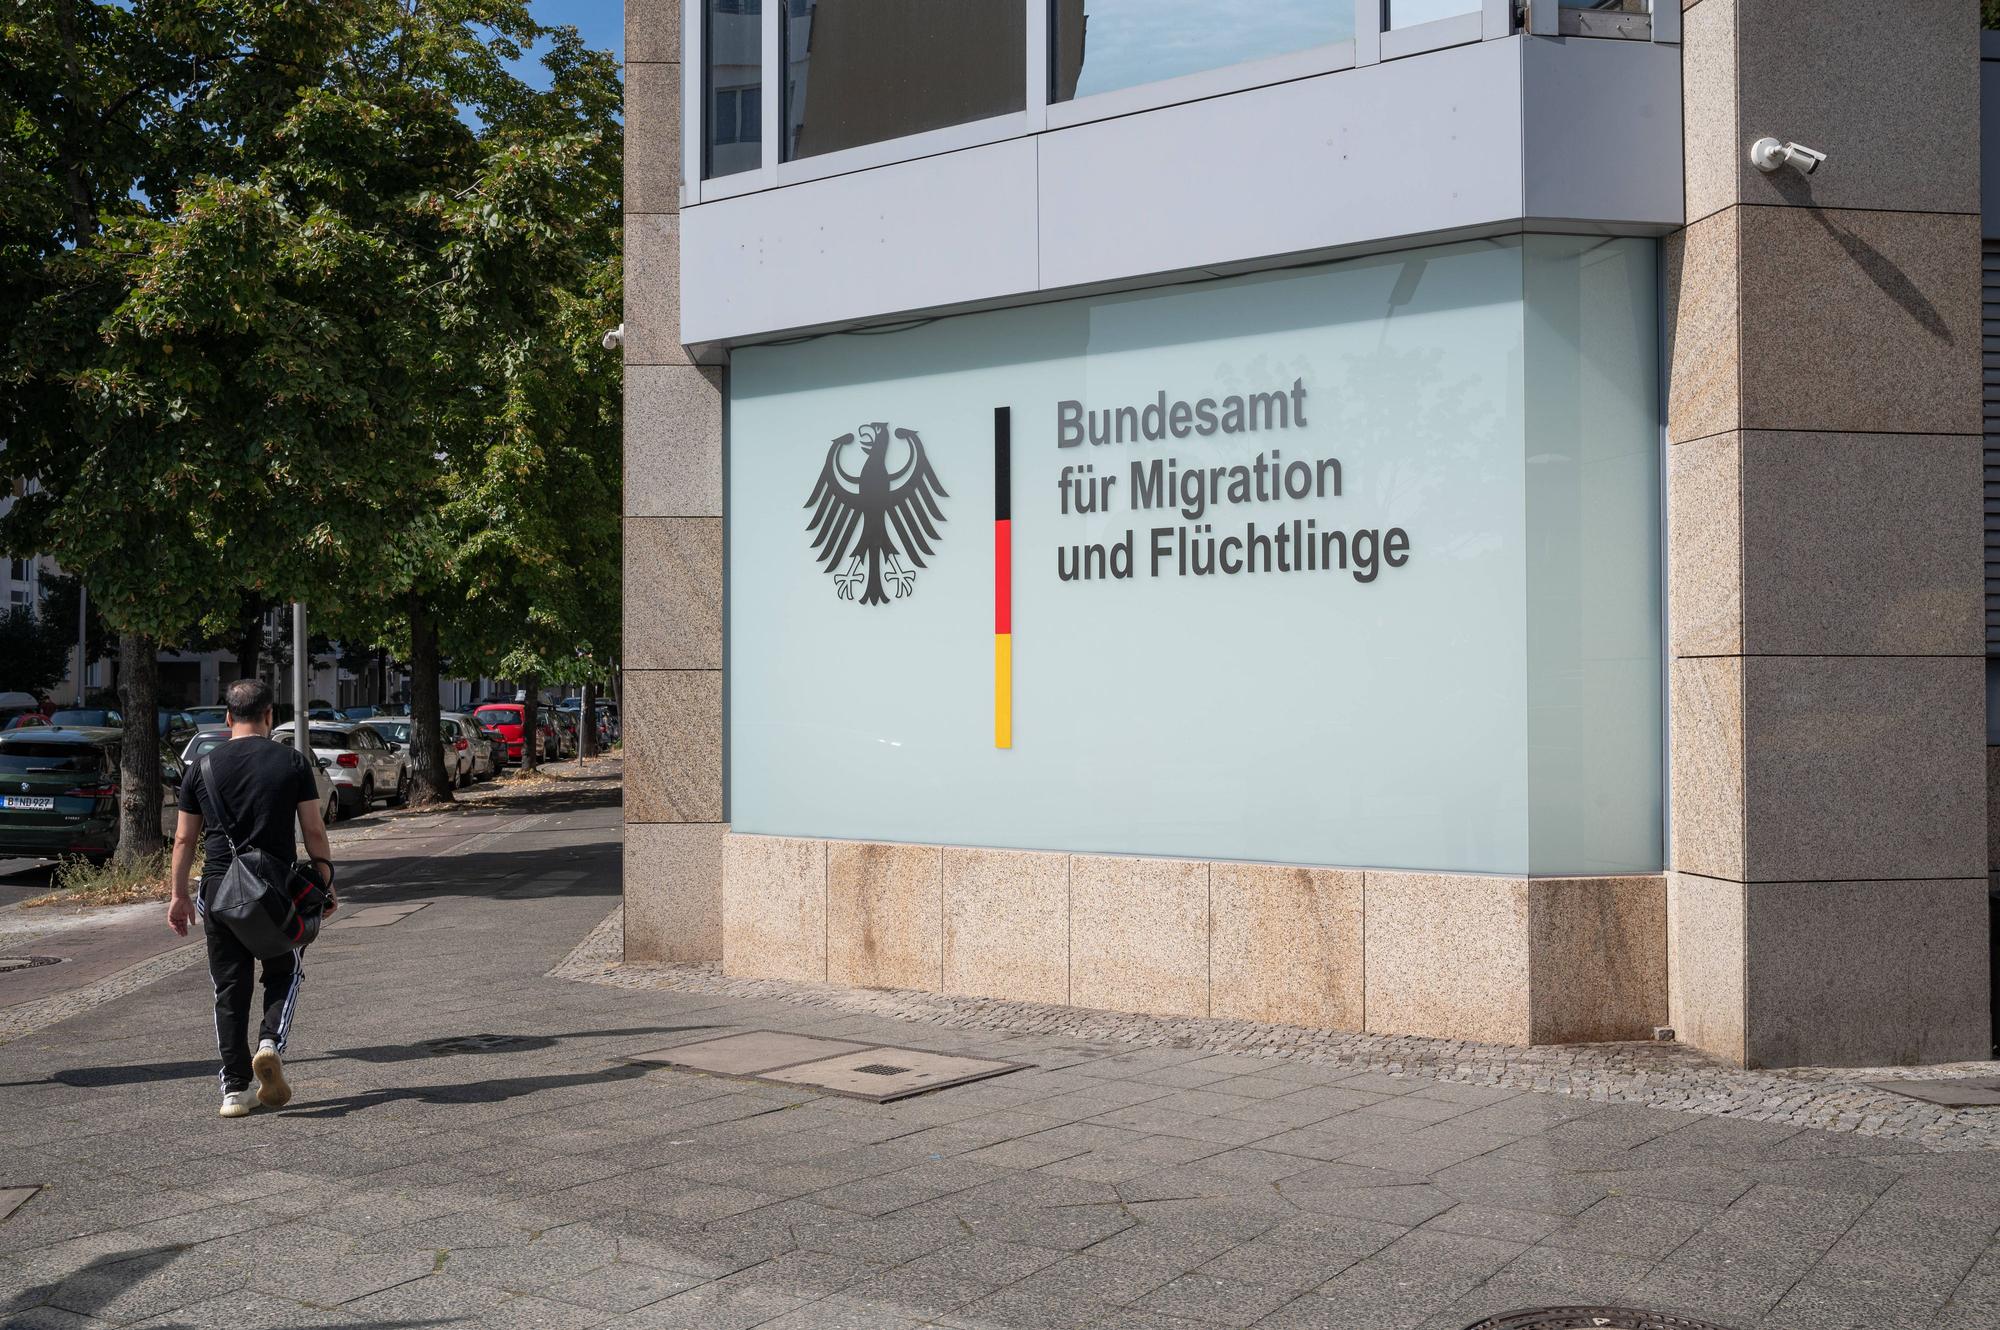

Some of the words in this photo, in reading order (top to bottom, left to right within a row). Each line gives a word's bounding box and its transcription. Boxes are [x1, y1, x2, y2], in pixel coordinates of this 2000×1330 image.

[1057, 376, 1308, 449] Bundesamt
[1057, 464, 1117, 515] für
[1130, 449, 1342, 520] Migration
[1057, 529, 1134, 582] und
[1150, 518, 1411, 583] Flüchtlinge
[7, 797, 14, 806] B
